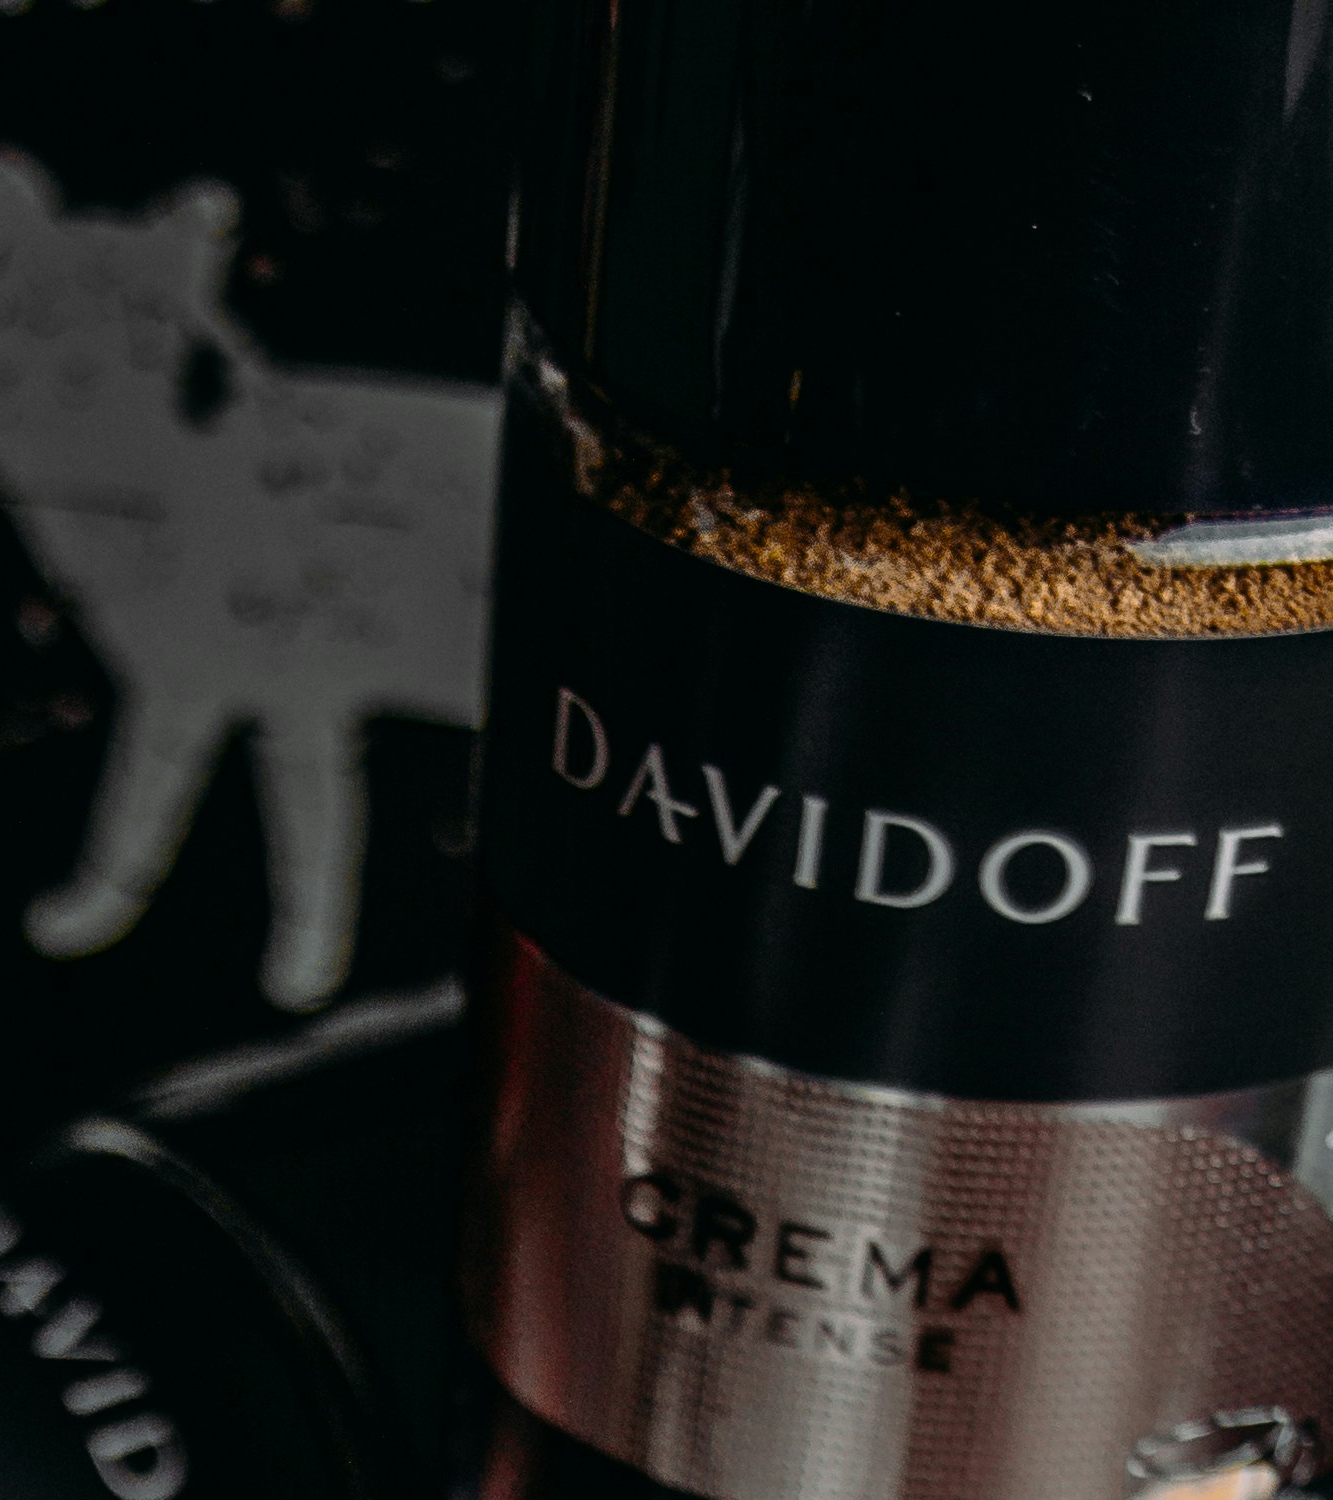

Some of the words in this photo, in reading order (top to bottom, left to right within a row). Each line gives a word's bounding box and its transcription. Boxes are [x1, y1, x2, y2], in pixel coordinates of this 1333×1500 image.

[550, 684, 1282, 928] DAVIDOFF
[620, 1173, 1022, 1311] CREMA
[654, 1258, 958, 1372] INTENSE
